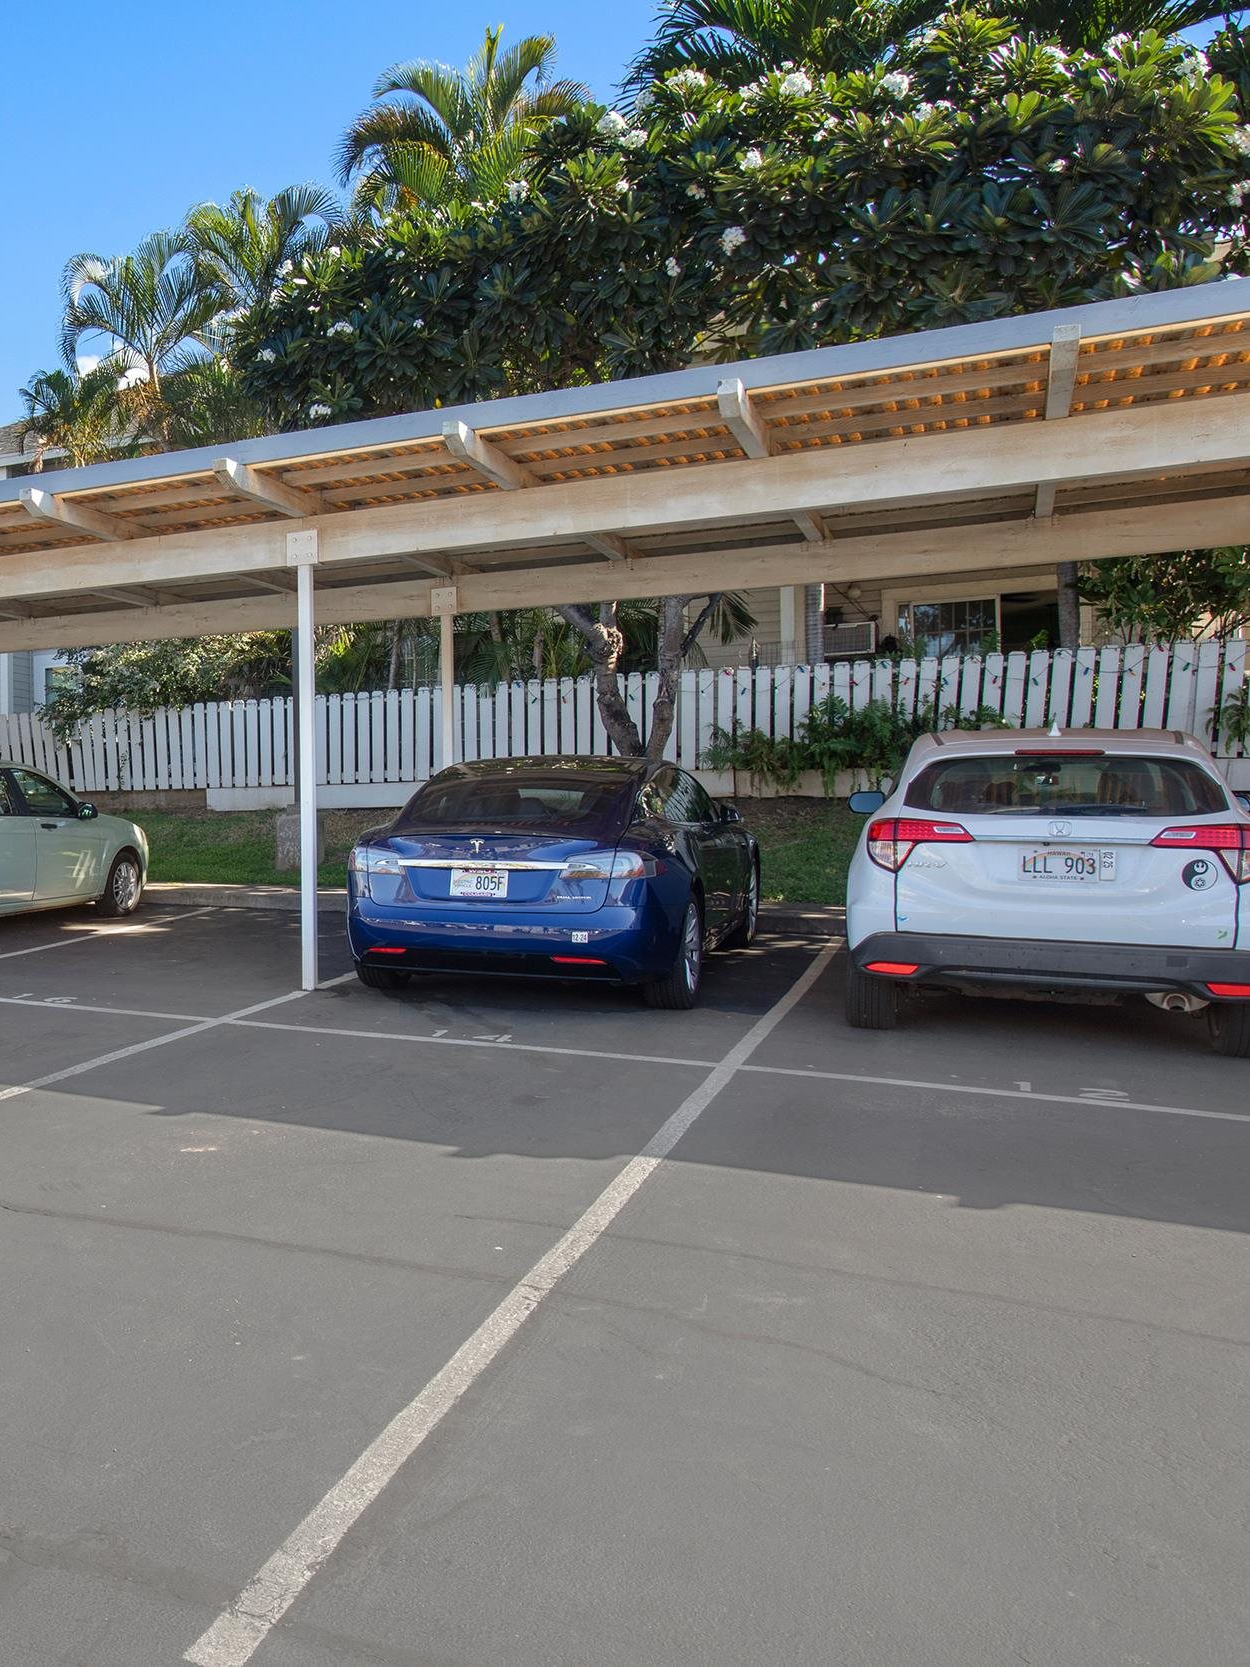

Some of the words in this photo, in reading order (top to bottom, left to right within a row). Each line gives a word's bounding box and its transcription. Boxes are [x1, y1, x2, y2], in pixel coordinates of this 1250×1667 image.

[1022, 855, 1053, 874] LLL
[1064, 857, 1096, 875] 903
[475, 875, 505, 891] 805F
